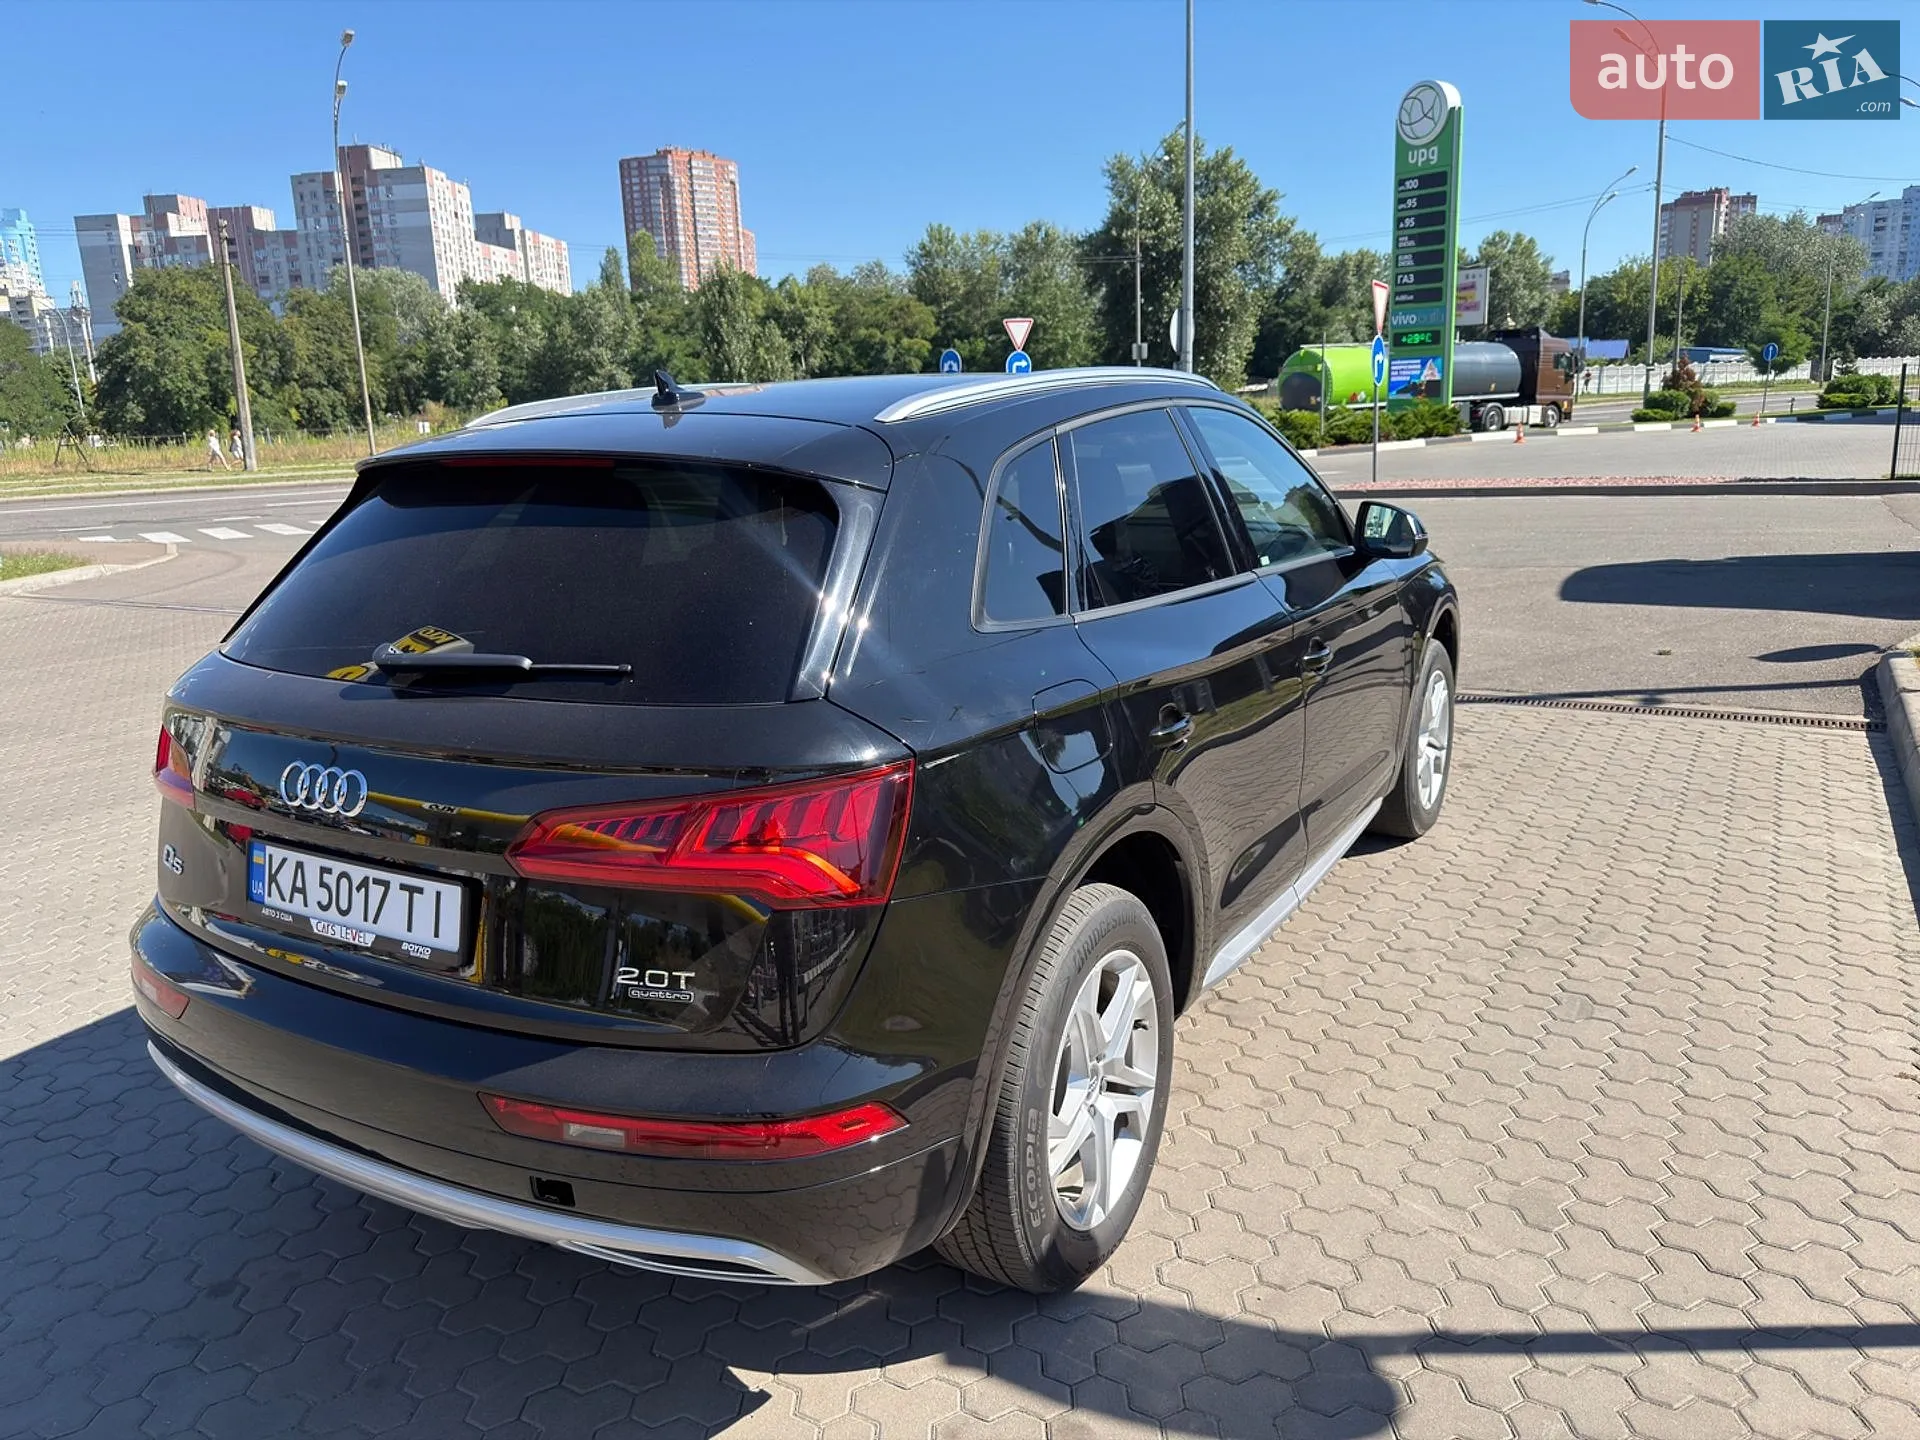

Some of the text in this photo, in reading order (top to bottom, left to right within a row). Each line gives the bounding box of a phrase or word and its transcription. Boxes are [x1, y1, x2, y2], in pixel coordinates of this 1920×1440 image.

[1408, 146, 1438, 167] upg
[1397, 273, 1415, 285] ГАЗ
[1391, 311, 1417, 325] vivo
[163, 844, 183, 875] Q5
[251, 879, 264, 895] UA
[267, 853, 441, 939] KA 5017 TI
[340, 926, 369, 945] LEVEL
[630, 989, 690, 1000] quattro
